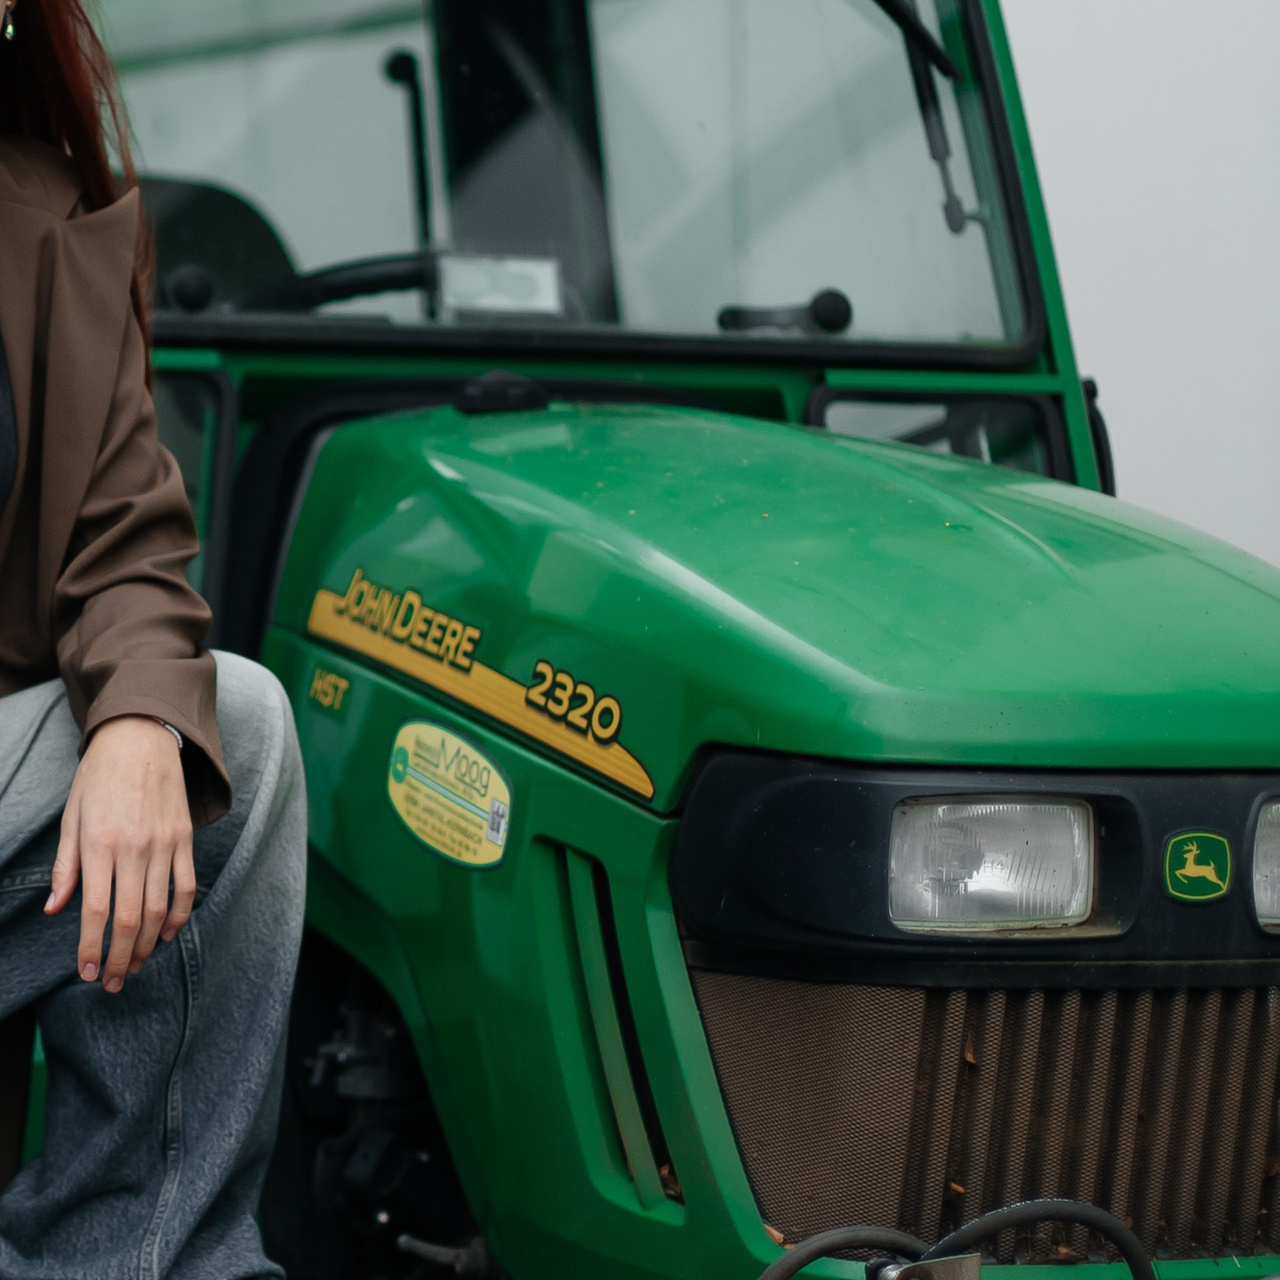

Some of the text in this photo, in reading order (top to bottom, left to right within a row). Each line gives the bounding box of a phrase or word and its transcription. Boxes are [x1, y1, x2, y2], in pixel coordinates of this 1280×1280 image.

[335, 568, 482, 671] JOHN DEERE
[310, 668, 349, 710] HST
[526, 660, 622, 741] 2320
